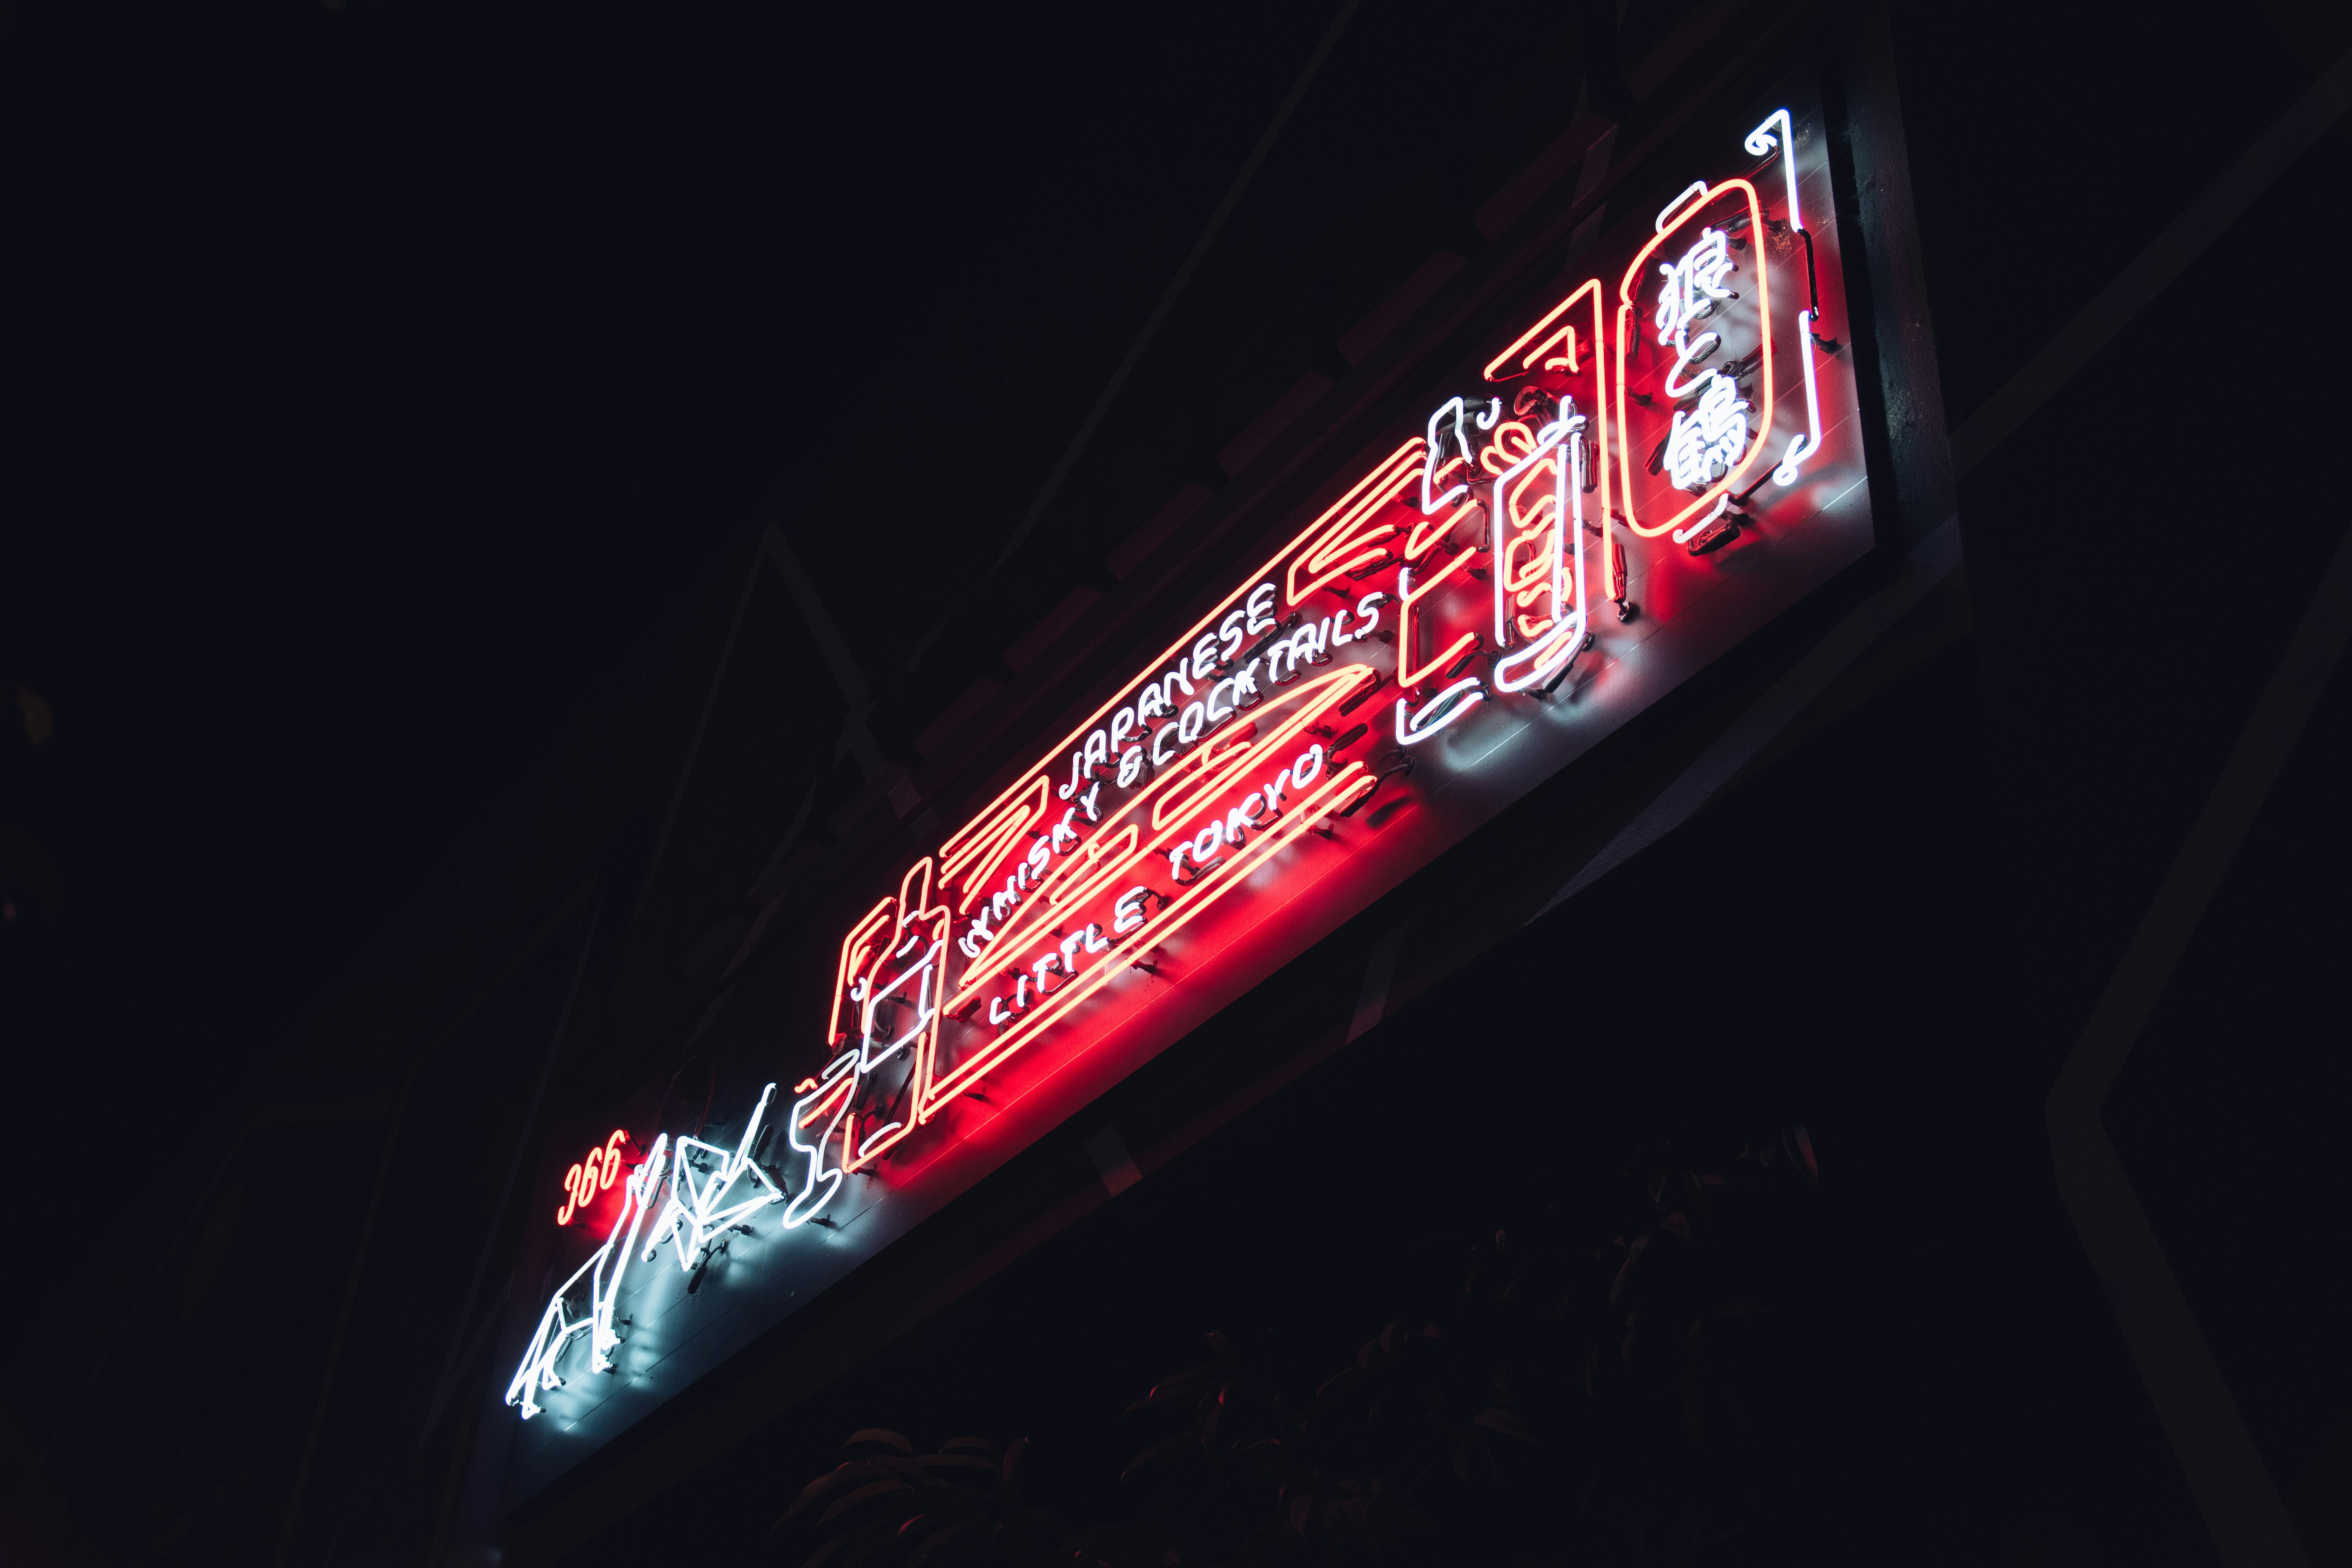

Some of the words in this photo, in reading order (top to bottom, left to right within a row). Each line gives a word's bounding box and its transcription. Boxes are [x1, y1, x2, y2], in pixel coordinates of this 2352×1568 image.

[958, 782, 1100, 958] WHISKY
[1117, 746, 1143, 788] &
[1152, 592, 1384, 766] COCKTAILS
[1058, 583, 1277, 800] JAPANESE
[989, 886, 1147, 1025] LITTLE
[1169, 744, 1323, 880] TOKYO
[557, 1129, 626, 1225] 366
